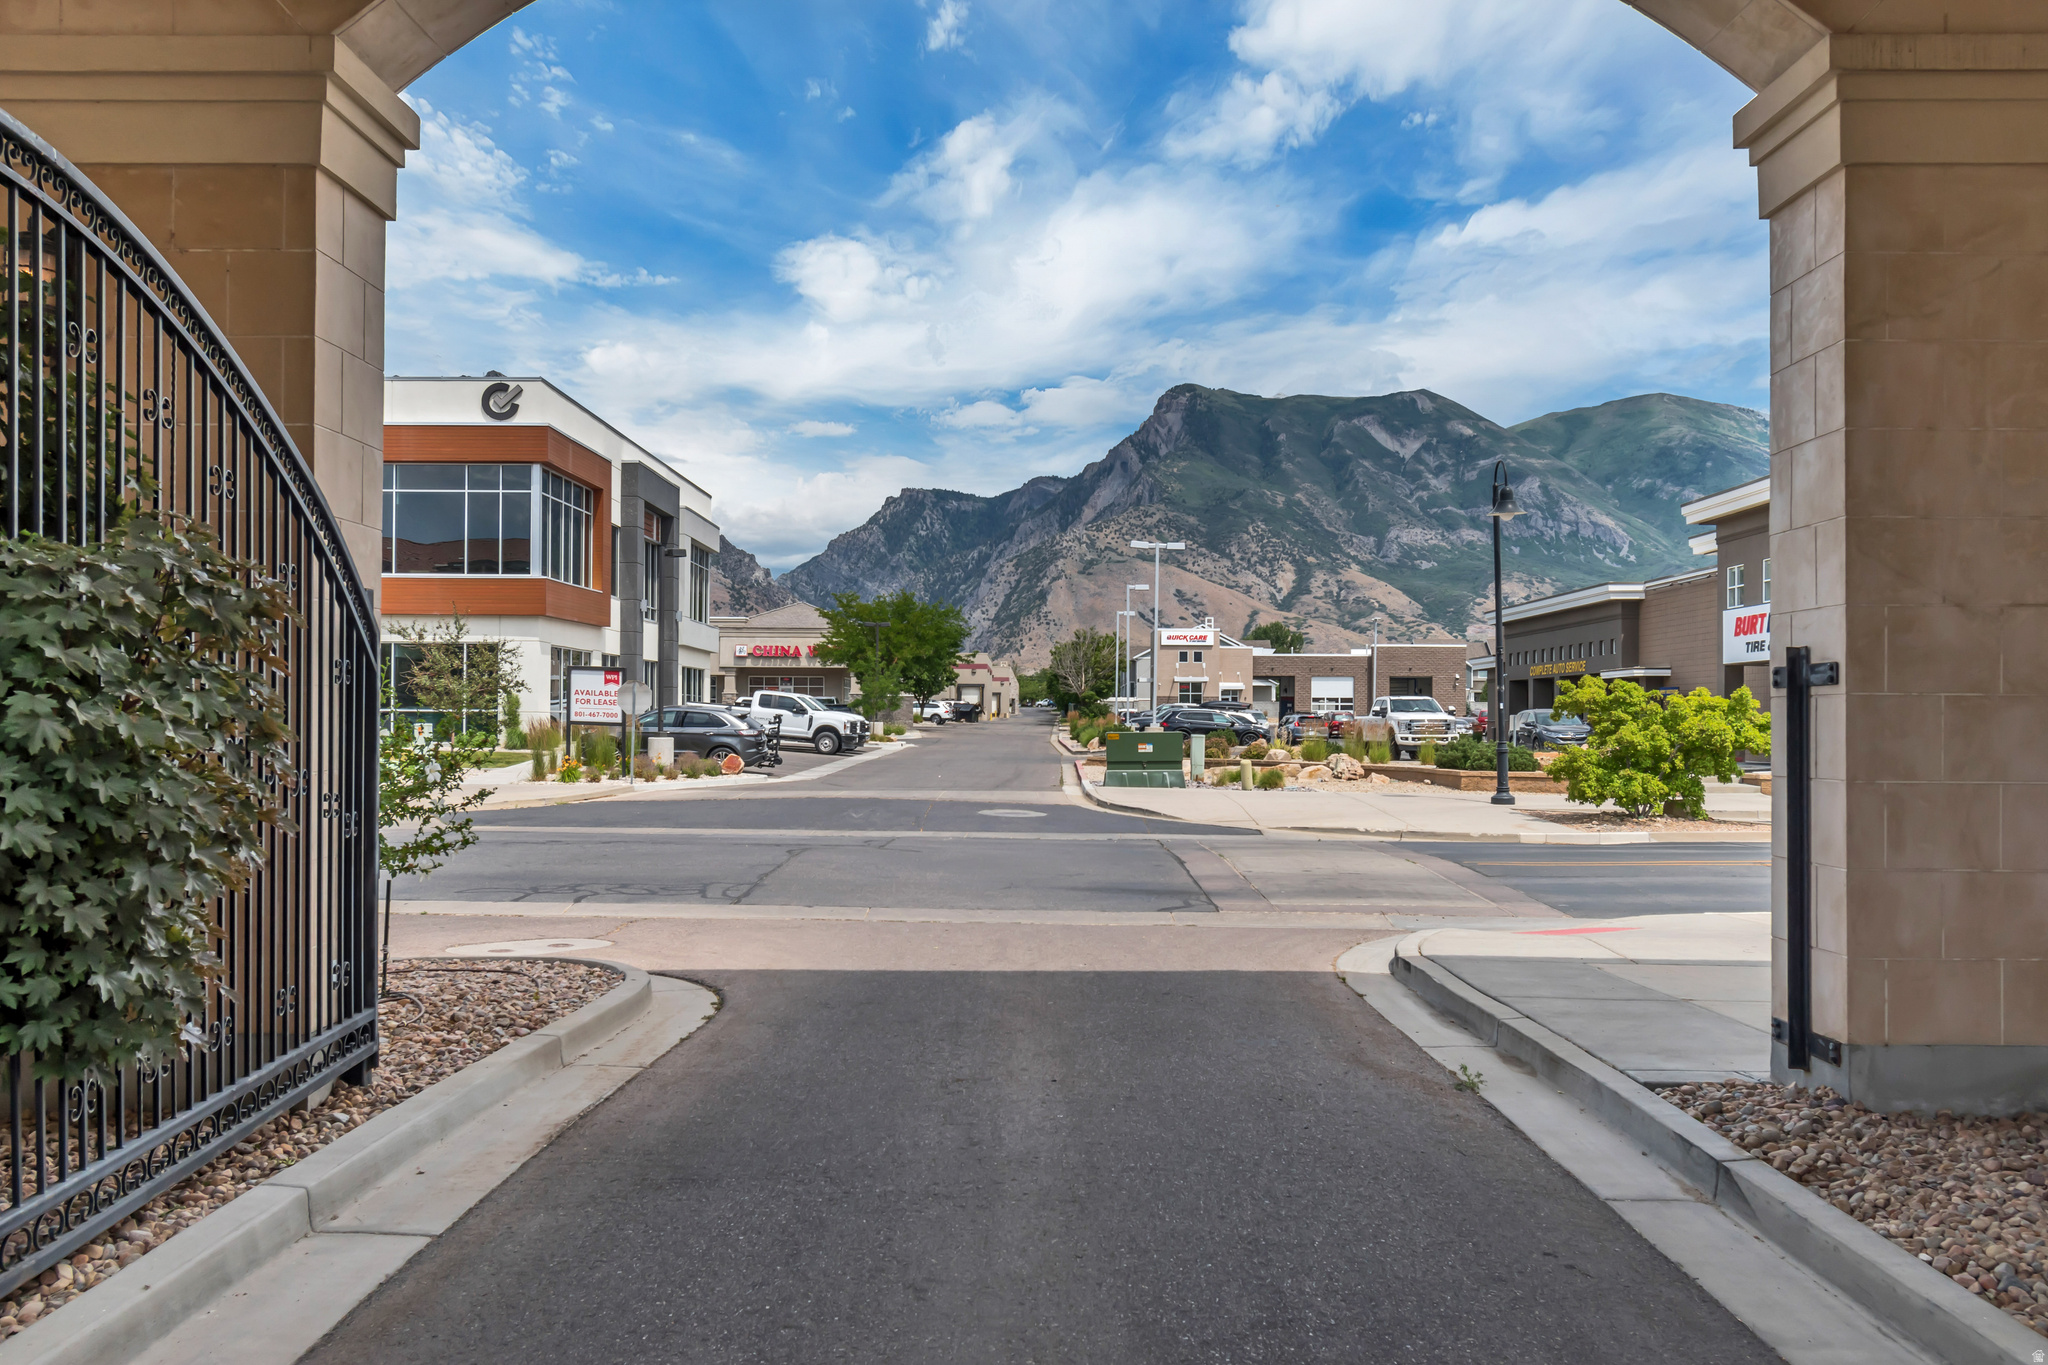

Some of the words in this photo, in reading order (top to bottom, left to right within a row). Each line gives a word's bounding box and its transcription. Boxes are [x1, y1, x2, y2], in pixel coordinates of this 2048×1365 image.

[1734, 612, 1767, 637] BURT
[1166, 634, 1188, 642] QUICK
[752, 645, 802, 657] CHINA
[1746, 640, 1766, 653] TIRE
[1530, 664, 1552, 676] COMPLETE
[1553, 662, 1565, 674] AUTO
[1566, 660, 1586, 673] SERVICE
[574, 689, 619, 697] AVAILABLE
[593, 698, 618, 706] LEASE
[574, 711, 619, 719] 801-467-7000
